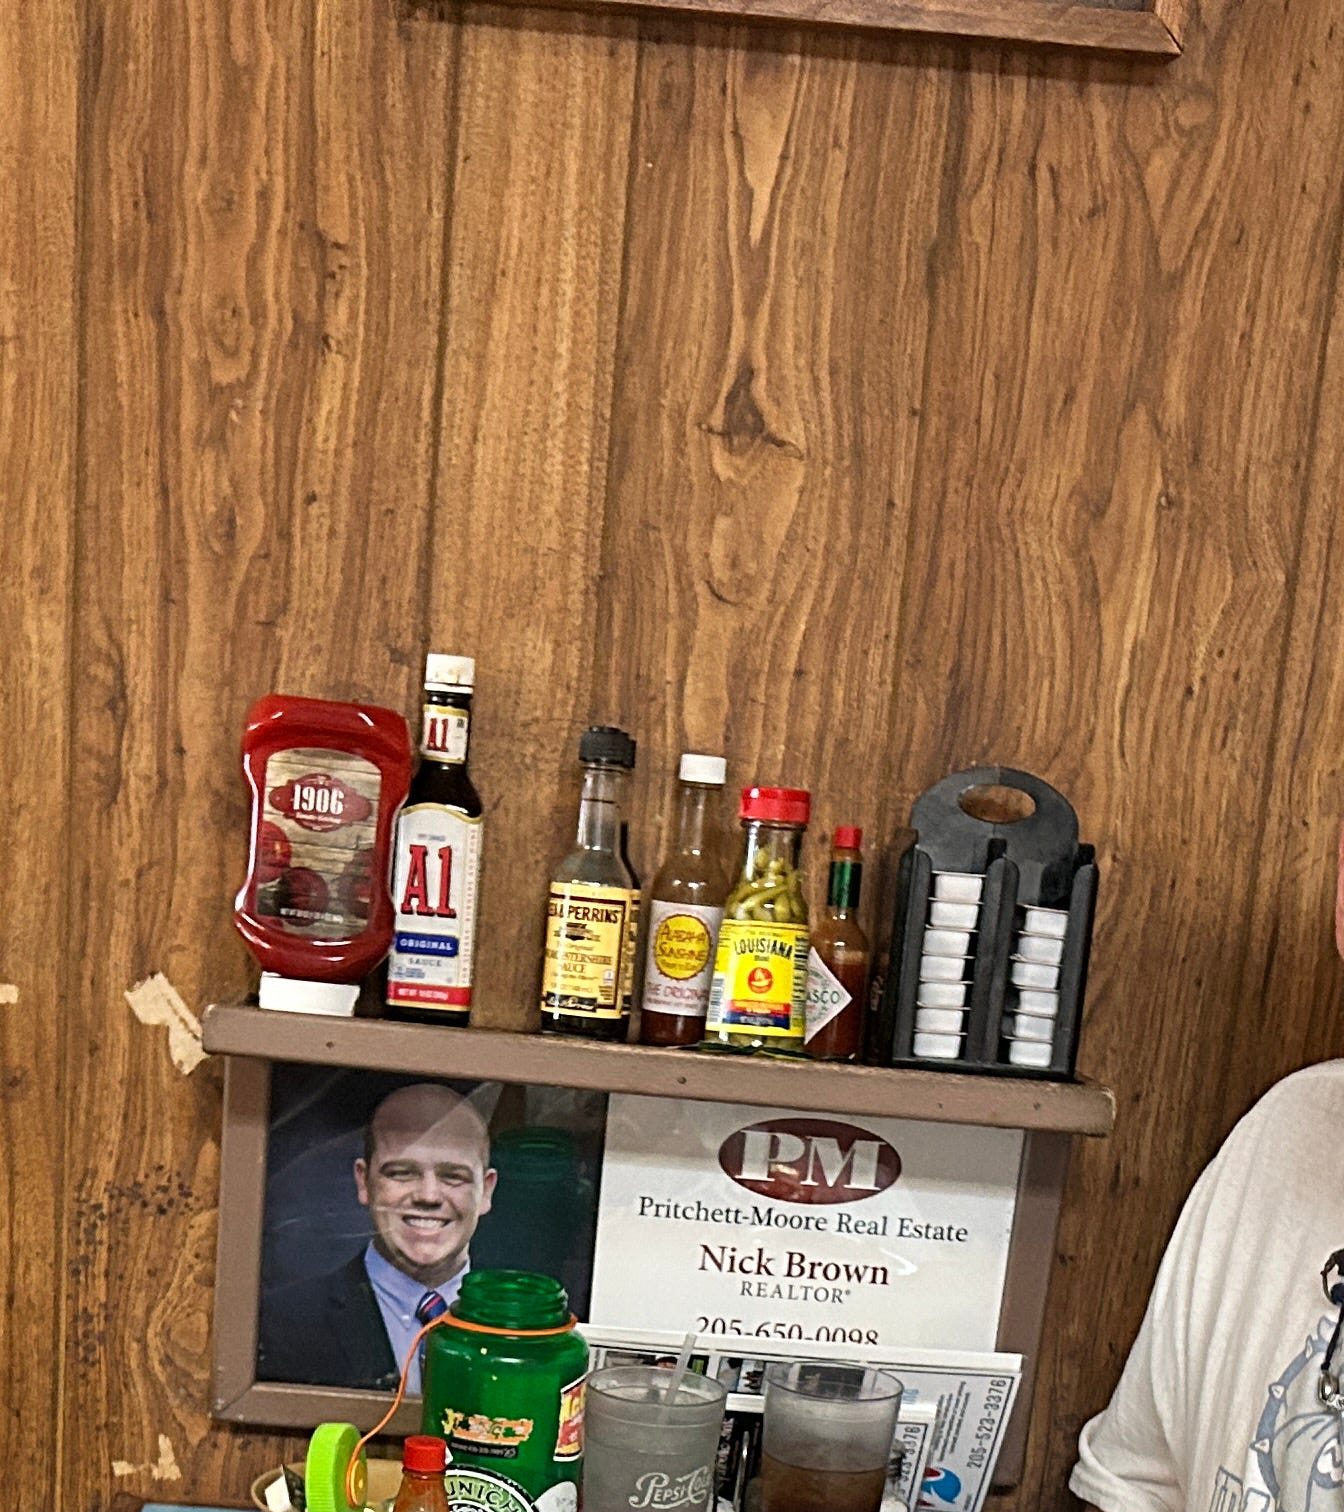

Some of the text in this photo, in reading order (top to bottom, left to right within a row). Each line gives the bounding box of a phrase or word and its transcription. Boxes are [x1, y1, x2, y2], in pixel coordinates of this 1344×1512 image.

[292, 783, 345, 815] 1906
[400, 843, 457, 919] A1
[568, 904, 619, 924] PERRINS
[399, 938, 453, 951] ORIGINAL
[734, 937, 793, 960] LOUISIANA
[408, 957, 442, 967] SAUCE
[735, 1129, 887, 1191] PM
[637, 1196, 969, 1243] Pritchett-Moore Real Estate
[697, 1244, 889, 1286] Nick Brown
